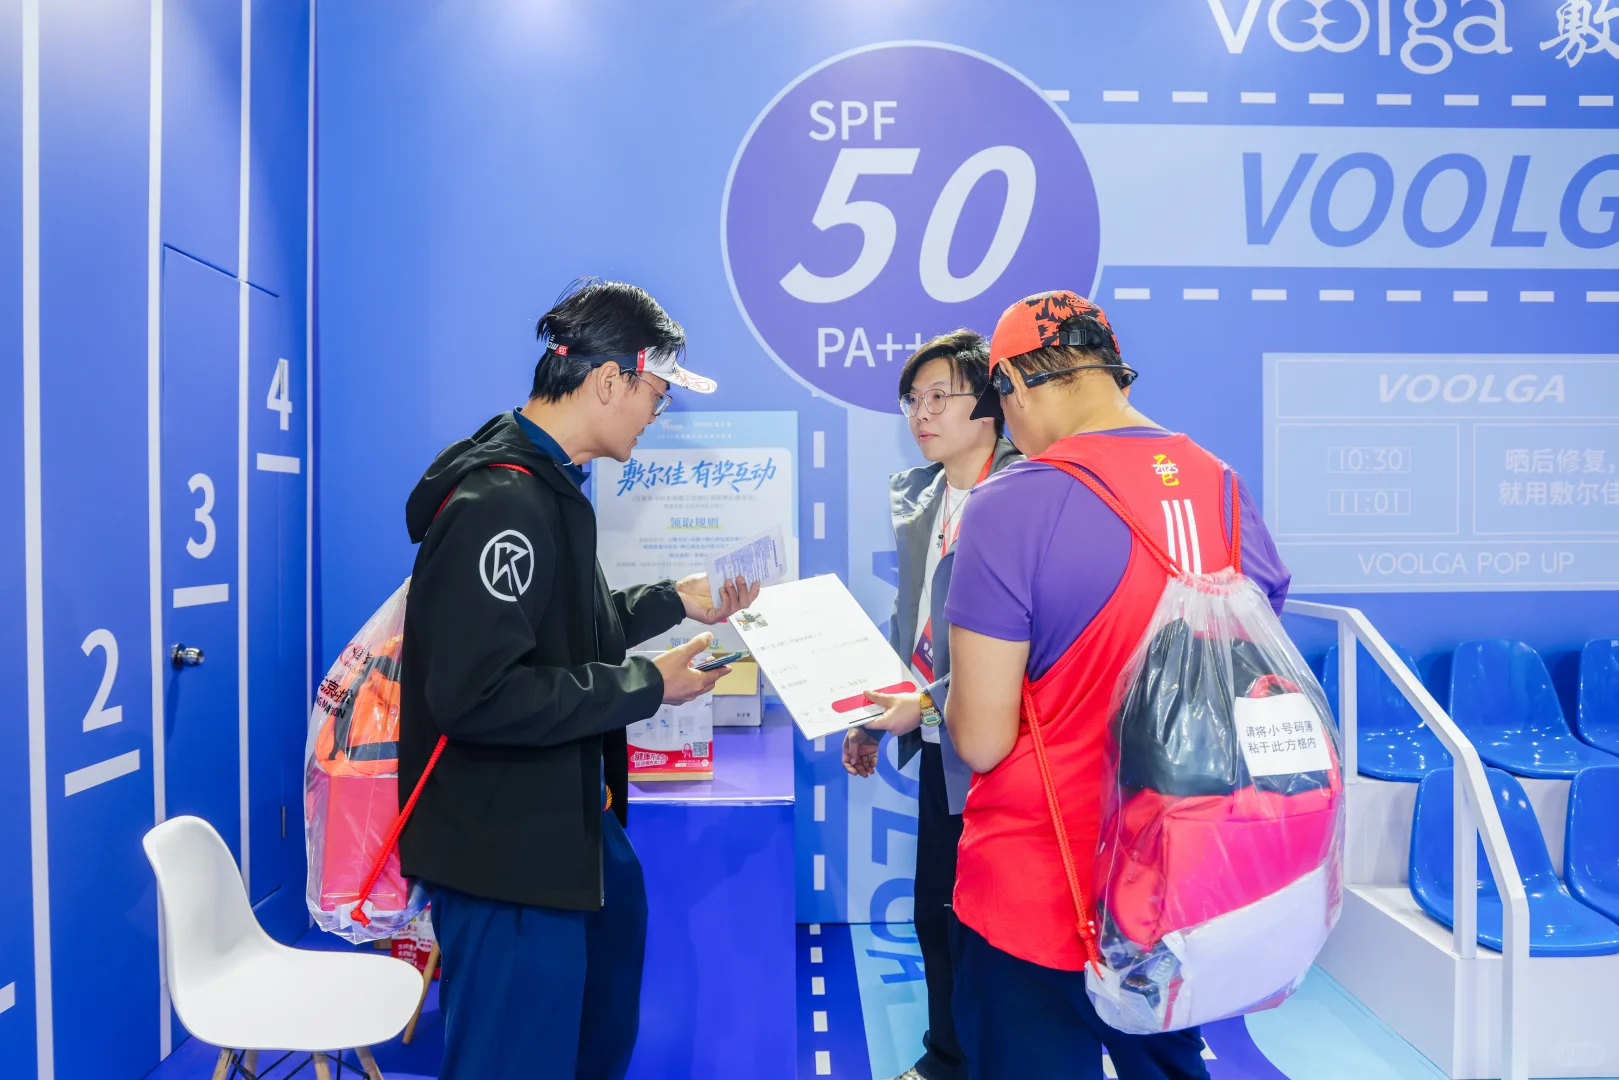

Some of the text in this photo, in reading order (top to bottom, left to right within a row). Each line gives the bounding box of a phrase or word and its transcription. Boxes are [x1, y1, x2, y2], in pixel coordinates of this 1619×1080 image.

[808, 100, 898, 142] SPF
[1242, 151, 1619, 249] VOOLG
[779, 144, 1037, 304] 50
[266, 358, 292, 431] 4
[1378, 373, 1567, 403] VOOLGA
[1339, 448, 1404, 471] 10:30
[185, 472, 216, 559] 3
[1339, 490, 1402, 513] 11:01
[669, 516, 720, 529] 领取规则
[1357, 551, 1575, 575] VOOLGA POP UP
[80, 628, 123, 733] 2
[1247, 737, 1317, 754] 粘于此方格内
